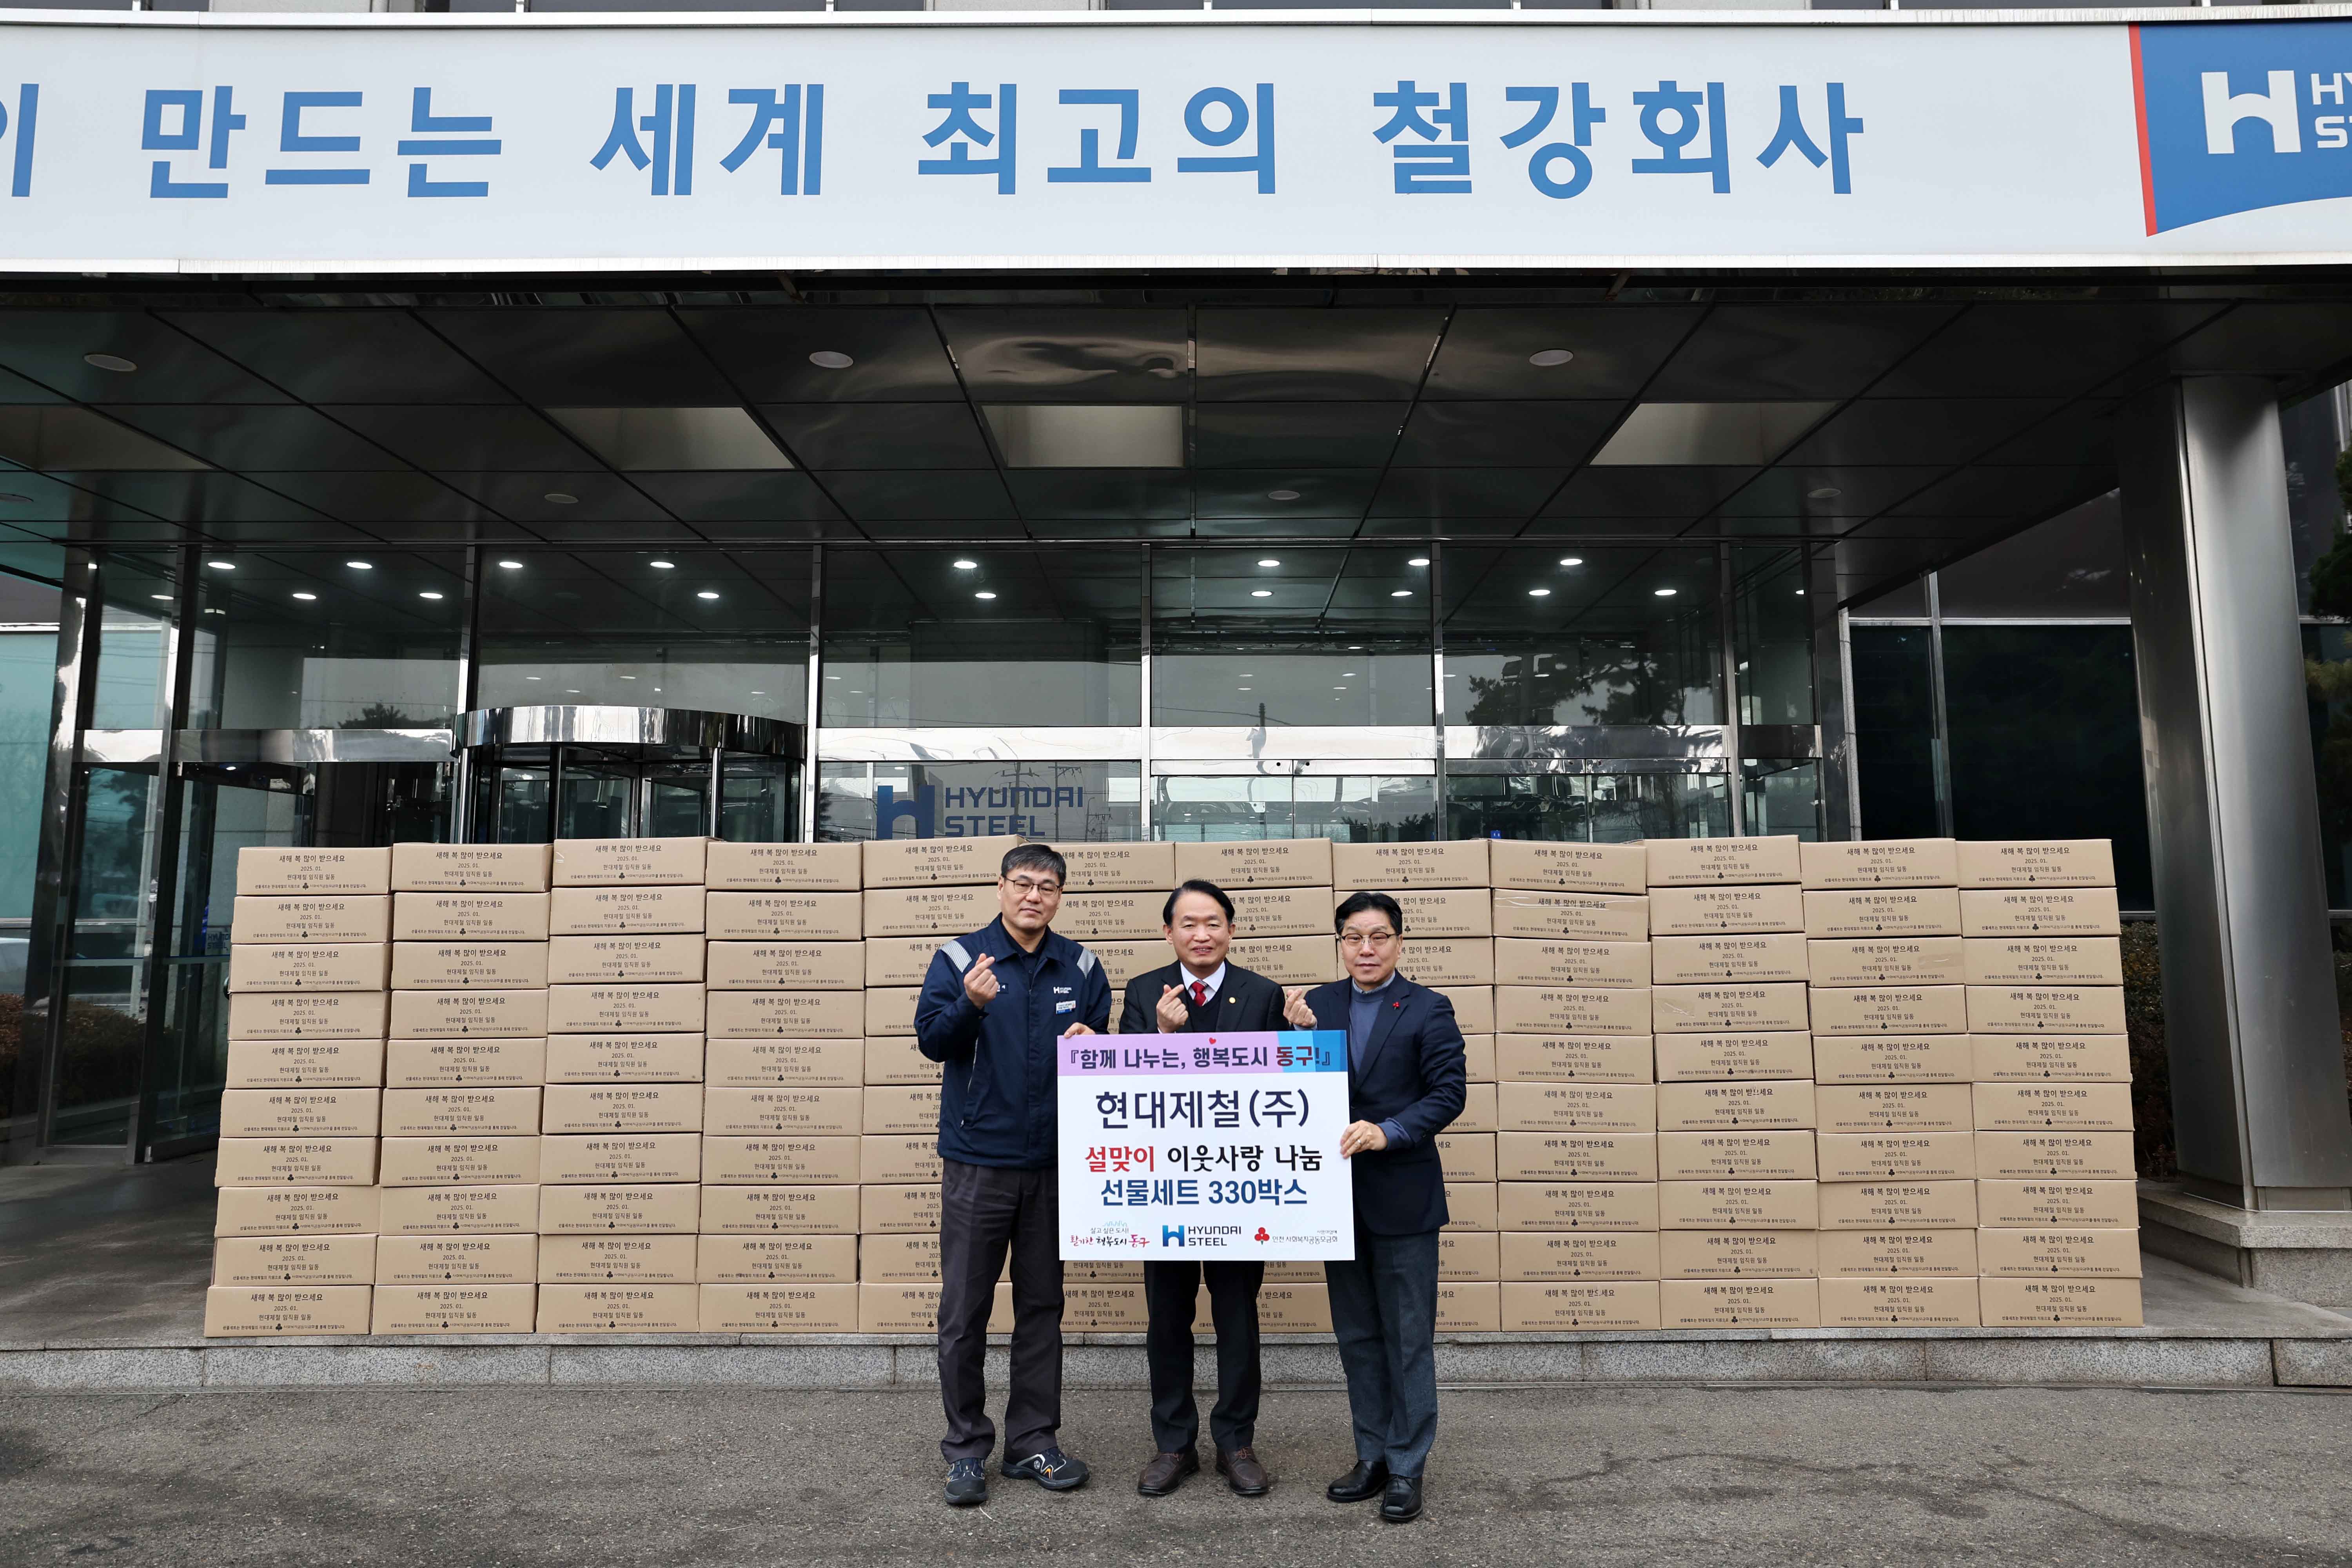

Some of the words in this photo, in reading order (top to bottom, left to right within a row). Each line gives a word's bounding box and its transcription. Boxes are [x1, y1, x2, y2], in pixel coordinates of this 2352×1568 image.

[142, 86, 501, 198] 만드는
[590, 84, 824, 195] 세계
[918, 82, 1275, 195] 최고의
[1373, 81, 1863, 199] 철강회사
[946, 786, 1083, 808] HYUNDAI
[945, 815, 1045, 837] STEEL
[1262, 847, 1289, 855] 받으세요
[1582, 995, 1609, 1003] 받으세요
[1903, 1043, 1930, 1051] 받으세요
[1071, 1050, 1116, 1069] 『함께
[1125, 1049, 1186, 1069] 나누는,
[1193, 1047, 1268, 1067] 행복도시
[1275, 1047, 1330, 1066] 동구!』
[1096, 1089, 1309, 1129] 현대제철(주)
[1085, 1146, 1154, 1172] 설맞이
[1167, 1145, 1264, 1172] 이웃사랑
[1275, 1145, 1322, 1171] 나눔
[1101, 1180, 1200, 1206] 선물세트
[1209, 1179, 1307, 1206] 330박스
[1189, 1226, 1242, 1235] HYUNDAI
[1070, 1235, 1093, 1247] 활기찬
[1096, 1236, 1127, 1247] 행복도시
[1129, 1234, 1150, 1248] 동구
[1189, 1238, 1228, 1247] STEEL
[1704, 1287, 1717, 1295] 새해
[1746, 1286, 1773, 1294] 받으세요
[2025, 1285, 2038, 1293] 새해
[2068, 1285, 2096, 1294] 받으세요
[251, 1294, 265, 1302] 새해
[295, 1293, 323, 1301] 받으세요
